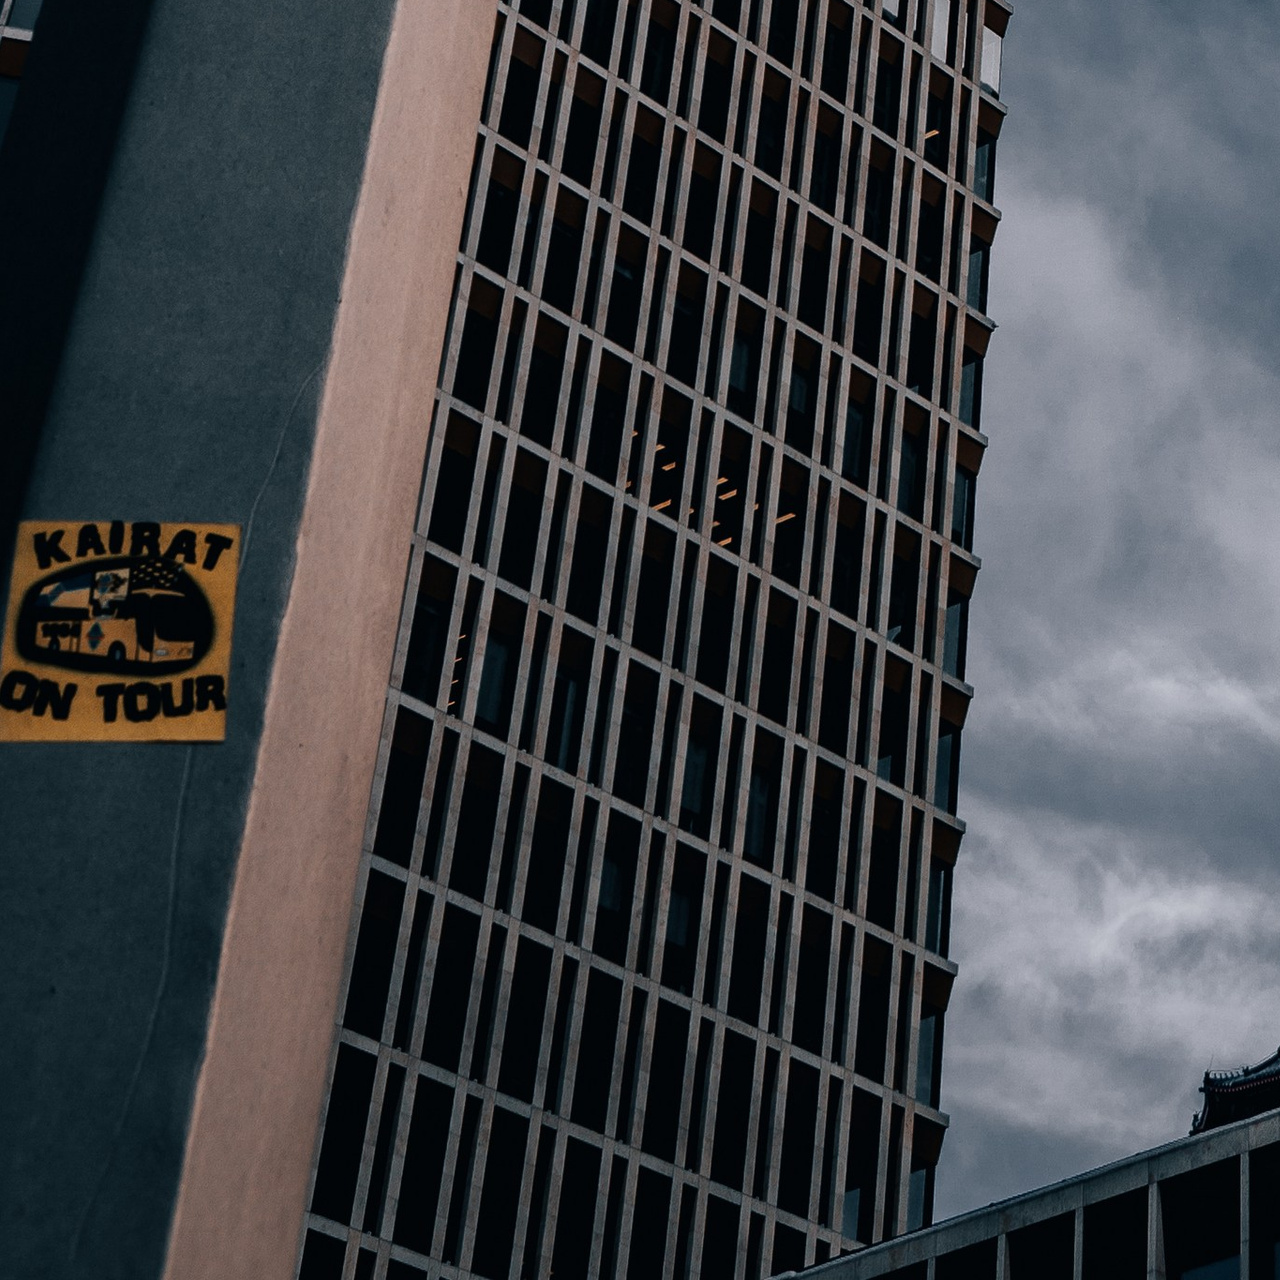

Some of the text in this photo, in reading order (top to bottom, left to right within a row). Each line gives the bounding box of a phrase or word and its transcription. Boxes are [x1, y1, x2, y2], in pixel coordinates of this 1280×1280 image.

[34, 521, 232, 569] KAIRAT
[0, 671, 226, 722] ON TOUR
